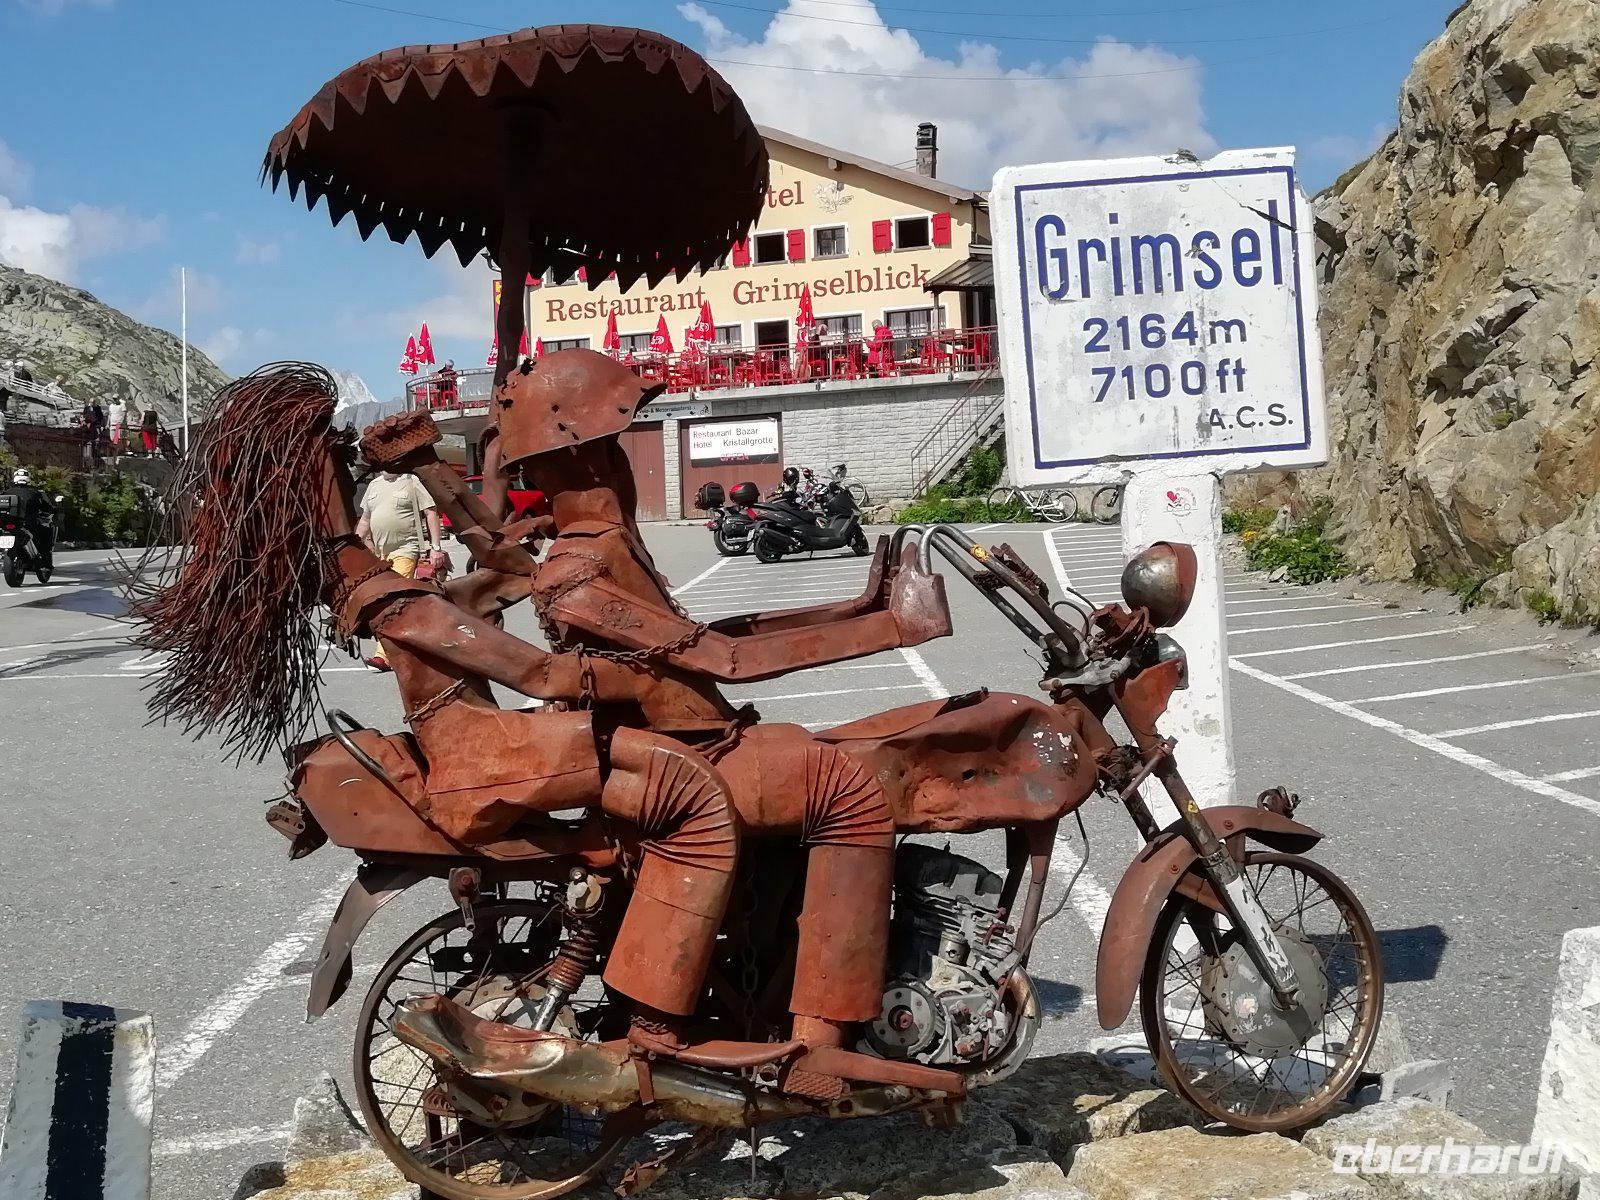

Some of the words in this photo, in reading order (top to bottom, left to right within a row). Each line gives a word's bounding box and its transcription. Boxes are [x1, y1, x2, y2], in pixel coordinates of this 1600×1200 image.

[766, 181, 804, 208] tel
[1034, 200, 1283, 300] Grimsel
[545, 286, 705, 322] Restaurant
[733, 263, 931, 305] Grimselblick
[1209, 403, 1294, 430] A.C.S.
[693, 429, 732, 439] Restaurant
[693, 440, 712, 449] Hotel
[723, 437, 773, 447] Kristallgrotte
